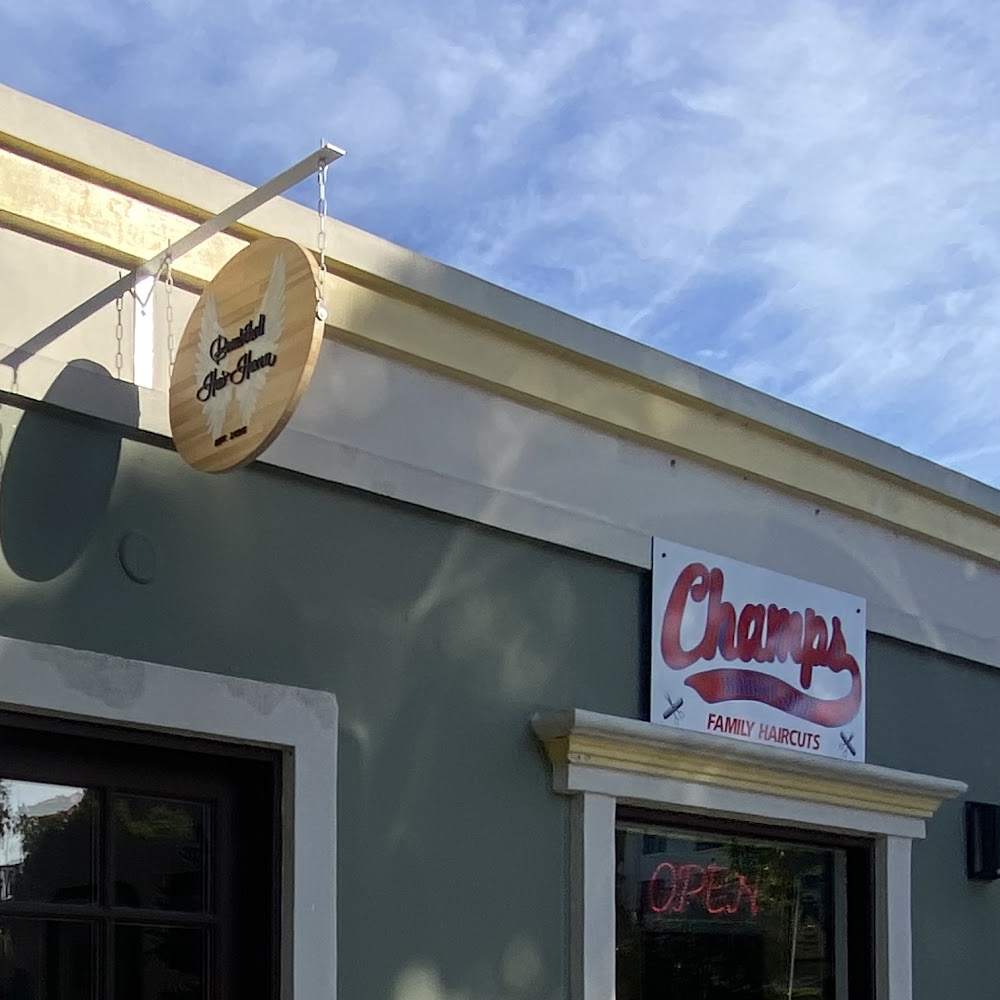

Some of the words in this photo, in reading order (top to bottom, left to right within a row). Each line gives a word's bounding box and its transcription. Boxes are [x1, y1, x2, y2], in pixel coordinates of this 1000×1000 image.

[661, 562, 855, 692] Champs
[707, 713, 755, 737] FAMILY
[758, 723, 821, 750] HAIRCUTS
[649, 862, 760, 916] OPEN
